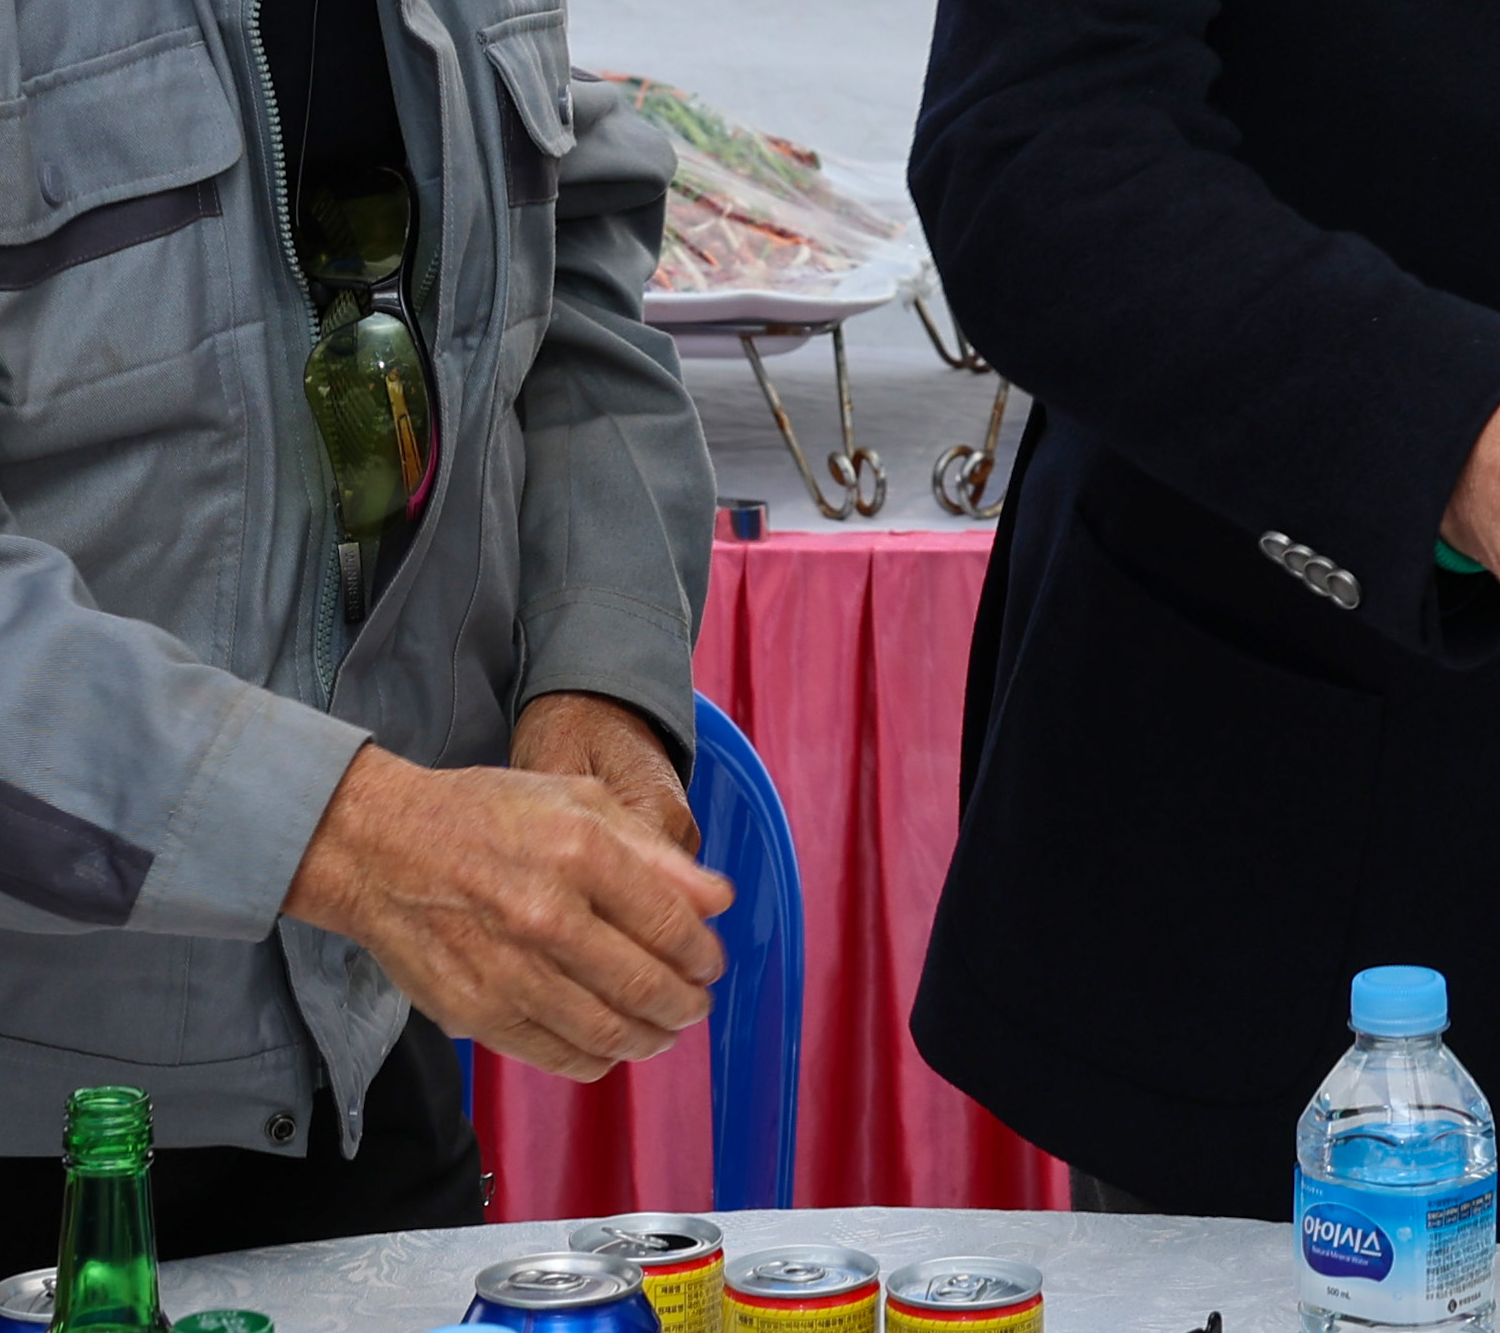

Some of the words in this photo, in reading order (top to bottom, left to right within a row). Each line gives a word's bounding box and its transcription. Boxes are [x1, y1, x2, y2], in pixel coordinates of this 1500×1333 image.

[344, 550, 360, 620] WINNERS
[1303, 1215, 1382, 1257] 아이시스
[1326, 1286, 1339, 1297] 500
